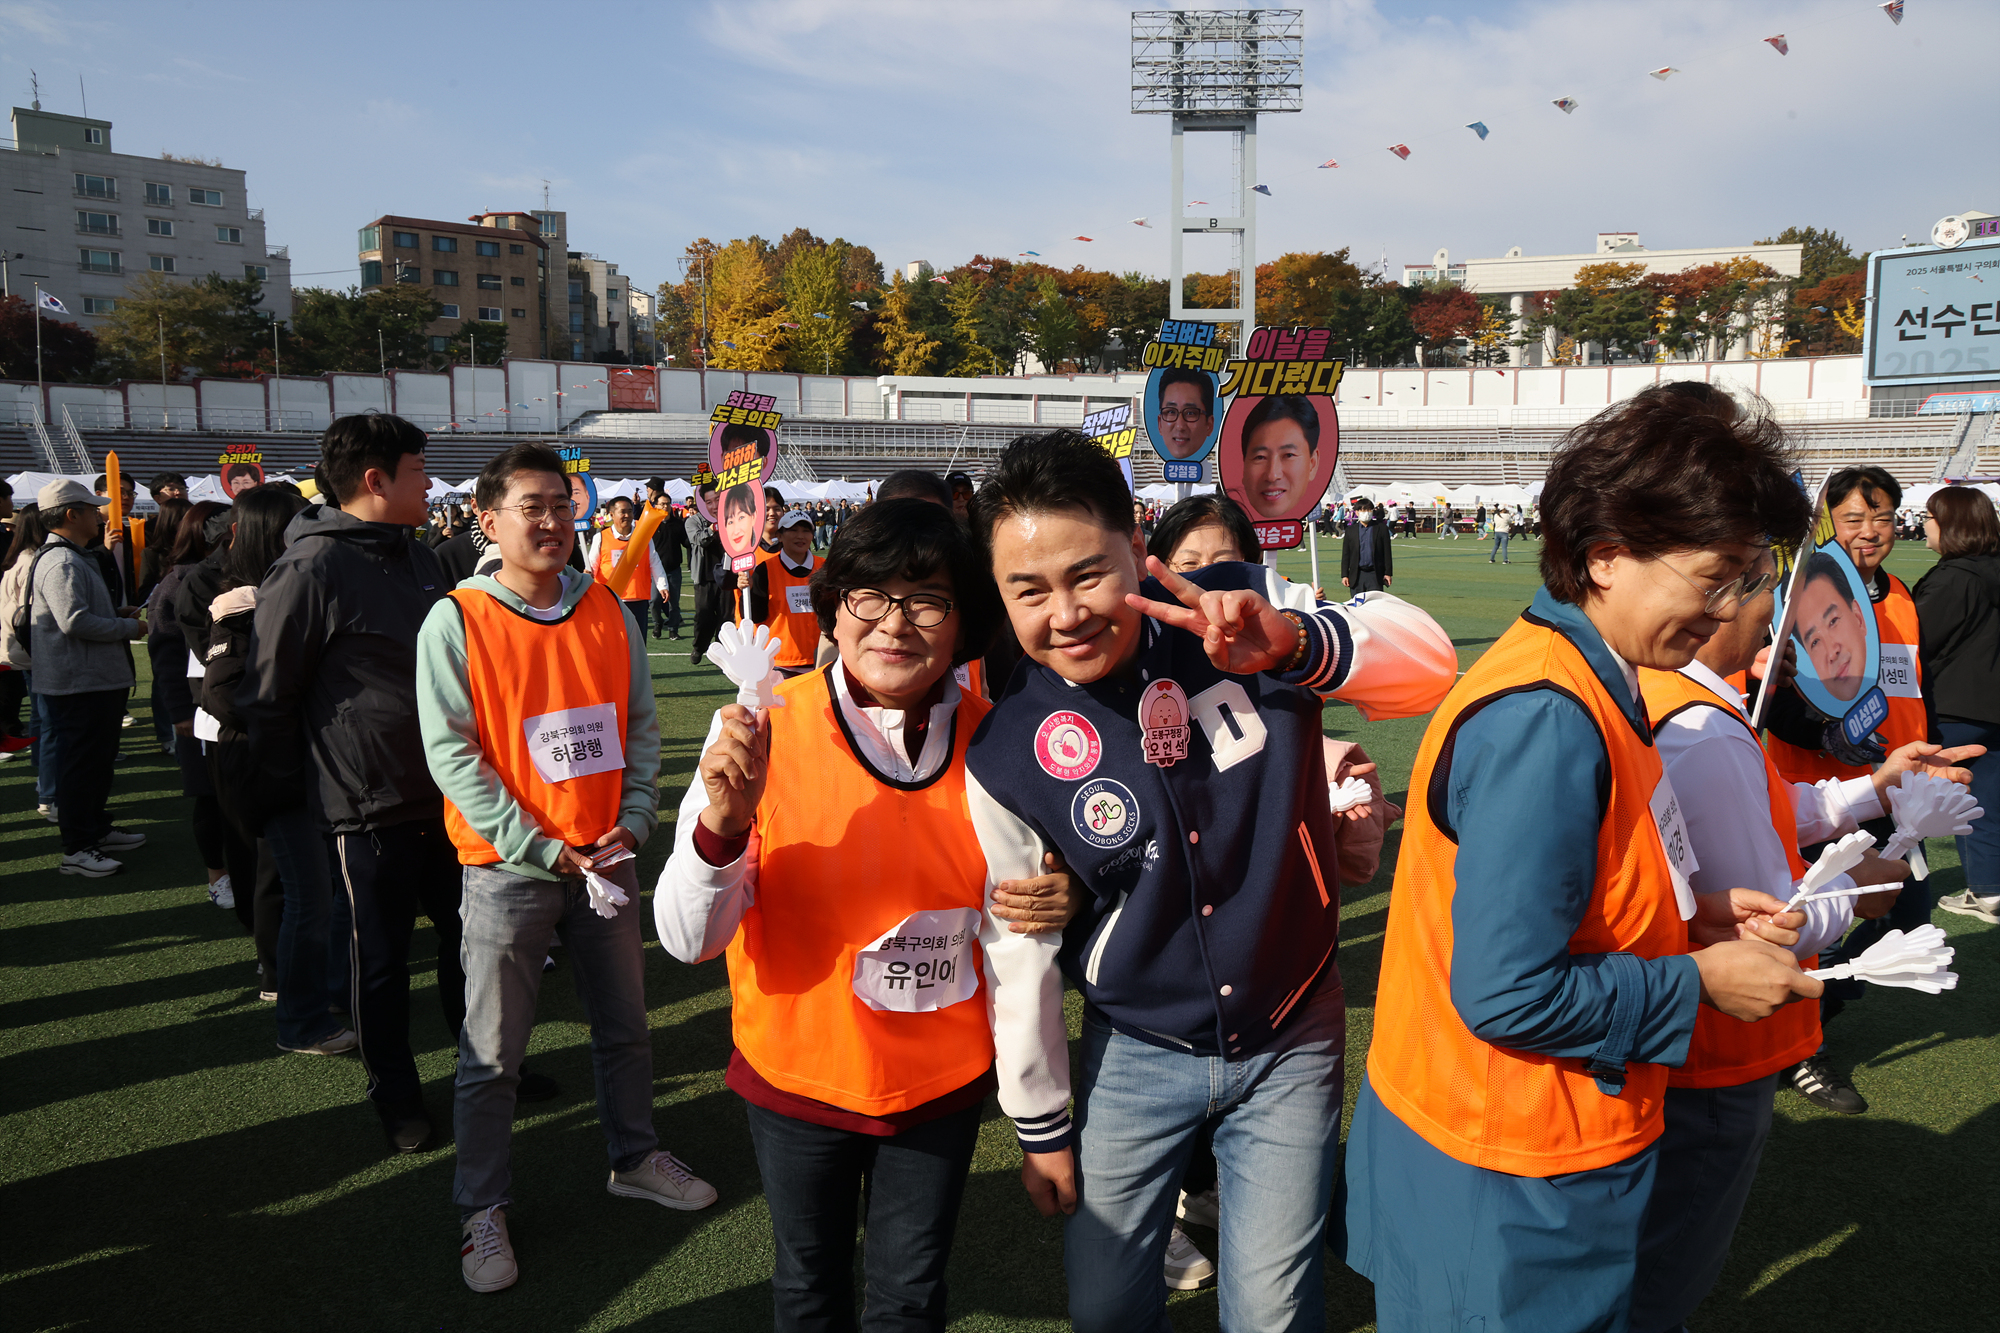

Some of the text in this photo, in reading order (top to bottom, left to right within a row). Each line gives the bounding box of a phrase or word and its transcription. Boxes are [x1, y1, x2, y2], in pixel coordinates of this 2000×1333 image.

[1209, 218, 1219, 229] B
[1906, 267, 1928, 277] 2025
[1929, 262, 1972, 275] 서울특별시
[1160, 320, 1215, 346] 덤벼라
[1894, 300, 2000, 341] 선수단
[1144, 342, 1224, 372] 이겨주마
[1248, 329, 1331, 360] 이날을
[1884, 346, 1991, 376] 2025
[1220, 361, 1344, 396] 기다렸다
[644, 386, 655, 403] 4
[726, 391, 776, 412] 최강팀
[711, 405, 782, 430] 도봉의회
[218, 452, 263, 464] 승리한다
[225, 444, 257, 454] 우리가
[723, 442, 756, 471] 하하하
[715, 457, 762, 492] 가소롭군
[1168, 464, 1198, 479] 강철웅
[733, 555, 753, 572] 강혜란
[1880, 655, 1897, 665] 구의회
[1188, 678, 1268, 773] D
[1848, 694, 1884, 738] 이성민
[540, 721, 604, 743] 강북구의회 의원
[1151, 728, 1182, 740] 도봉구청장
[551, 738, 604, 764] 허광행
[1080, 783, 1105, 802] SEOUL
[1088, 811, 1136, 845] DOBONG SOCKS
